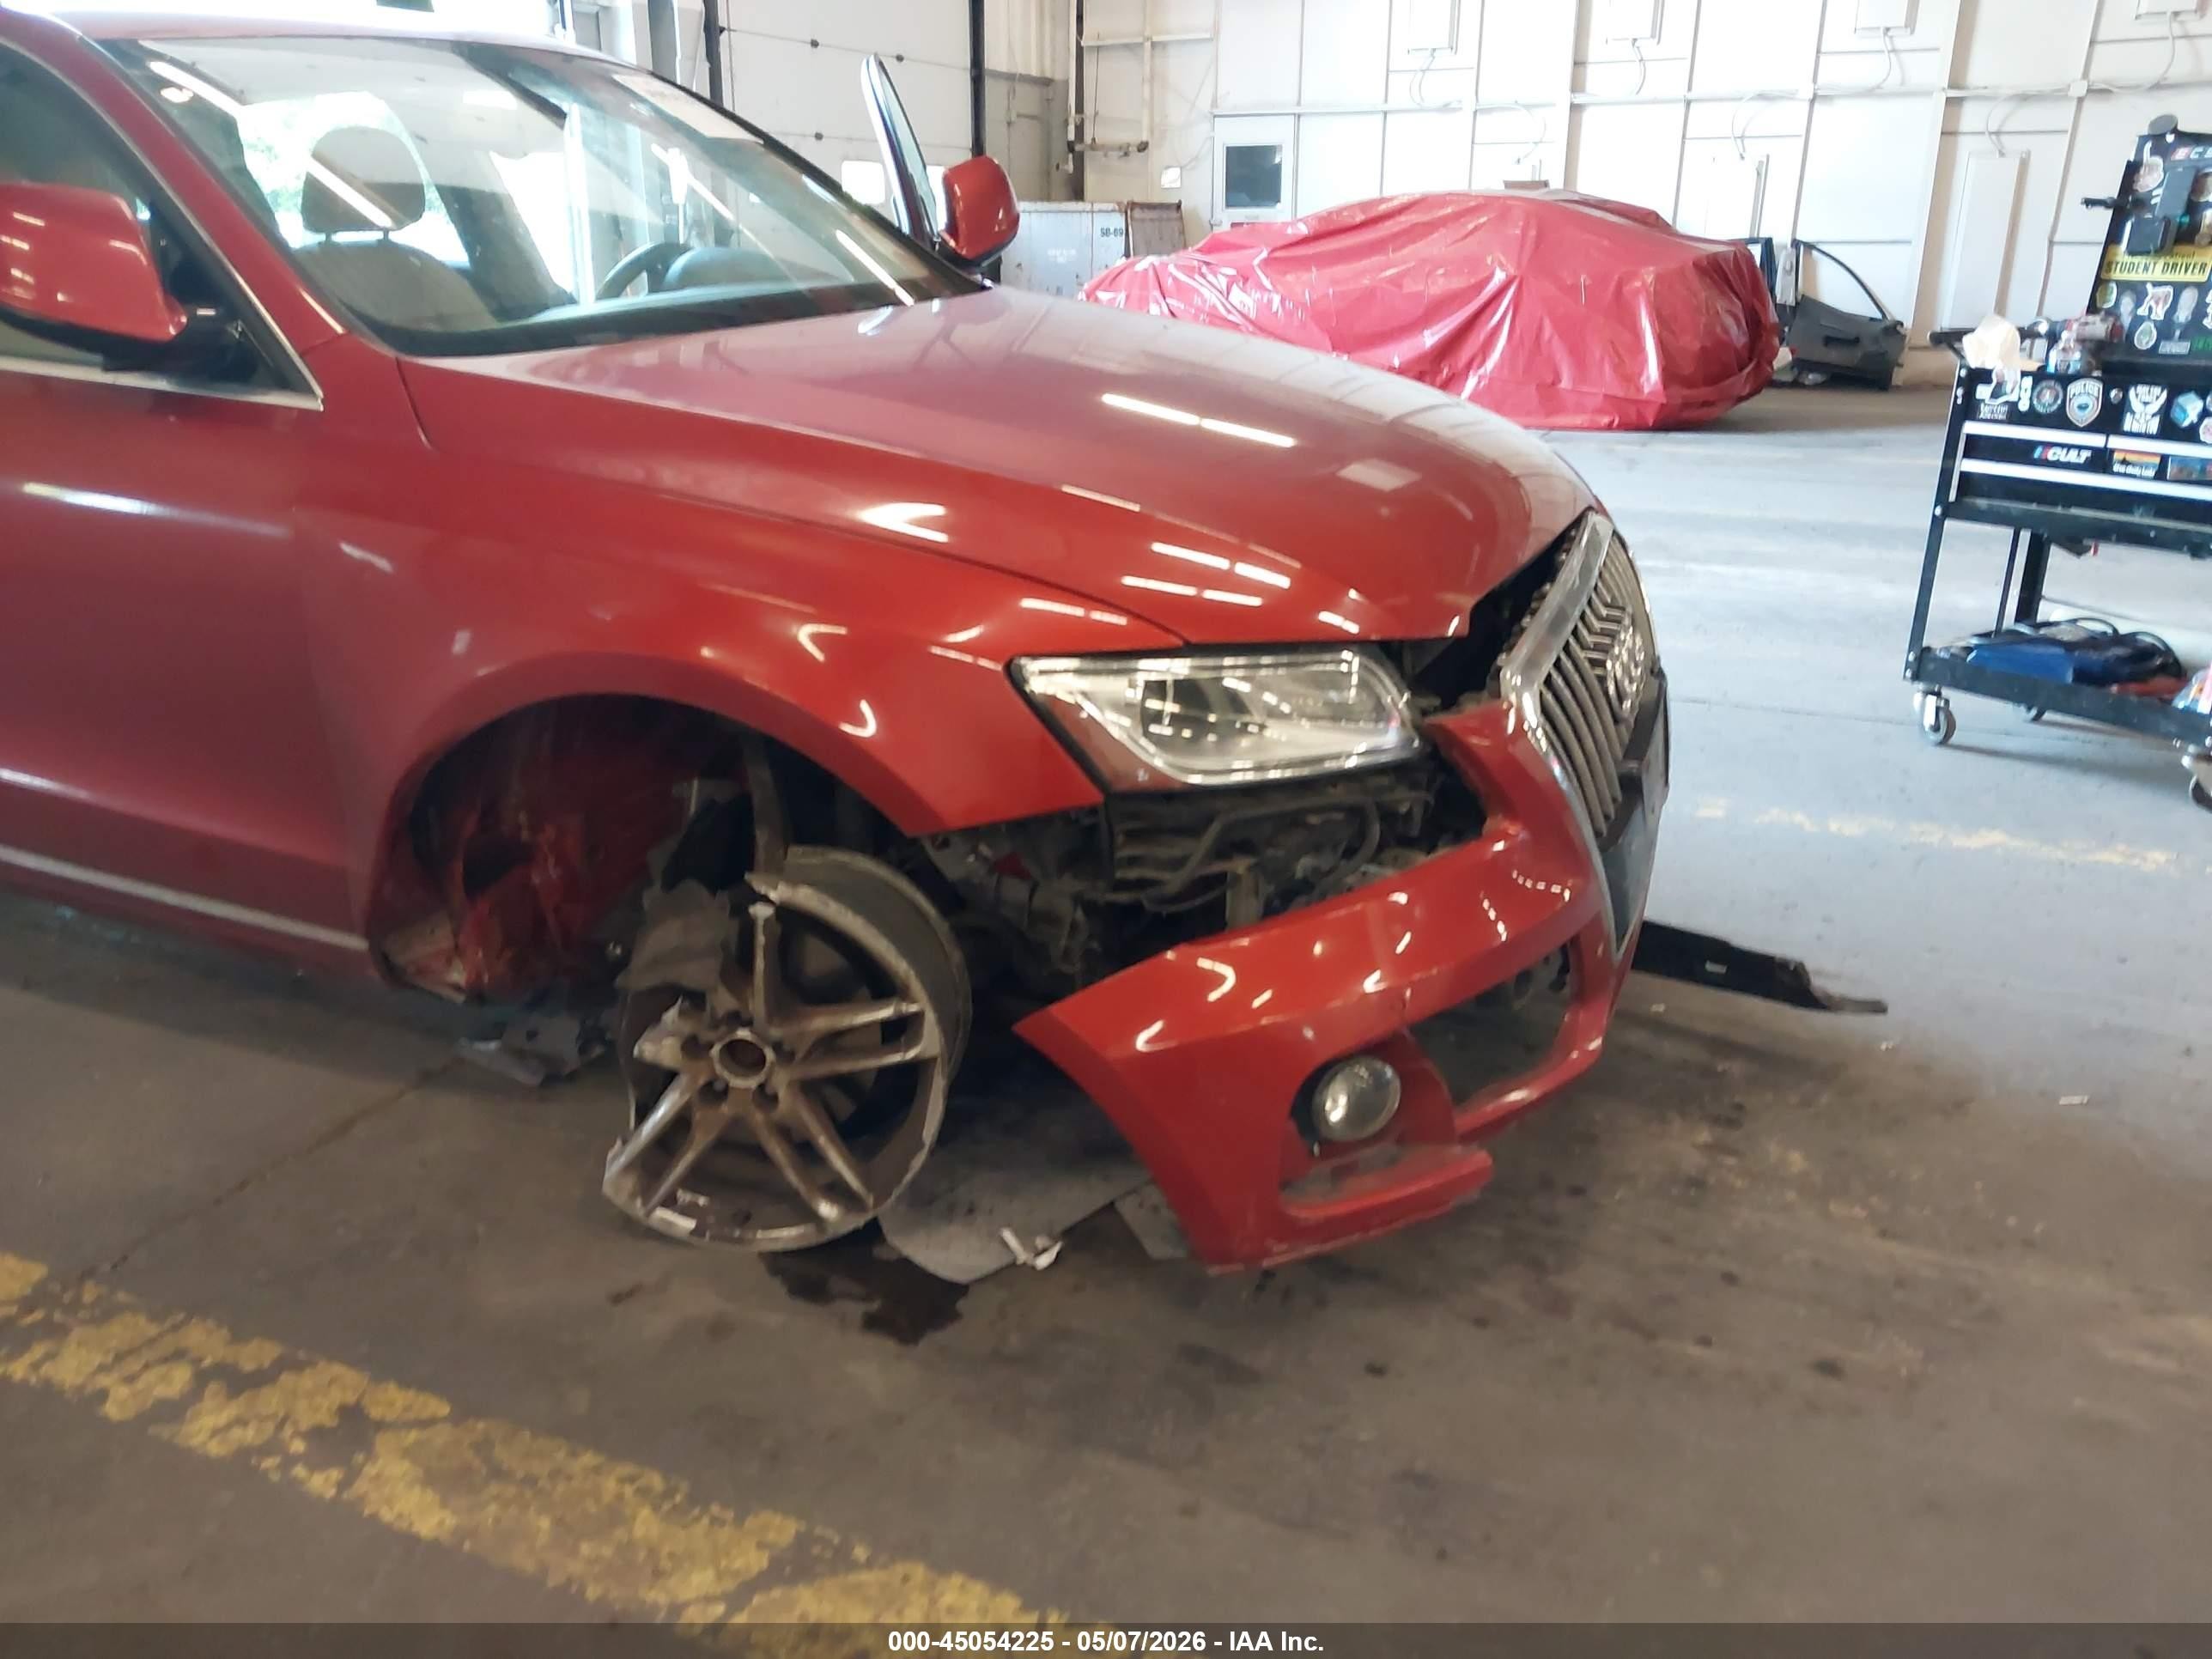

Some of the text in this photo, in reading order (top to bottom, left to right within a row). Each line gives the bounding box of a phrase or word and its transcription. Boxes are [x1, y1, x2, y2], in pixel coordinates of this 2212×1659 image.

[2106, 260, 2208, 276] STUDENT DRIVER
[2069, 380, 2100, 398] POLICE
